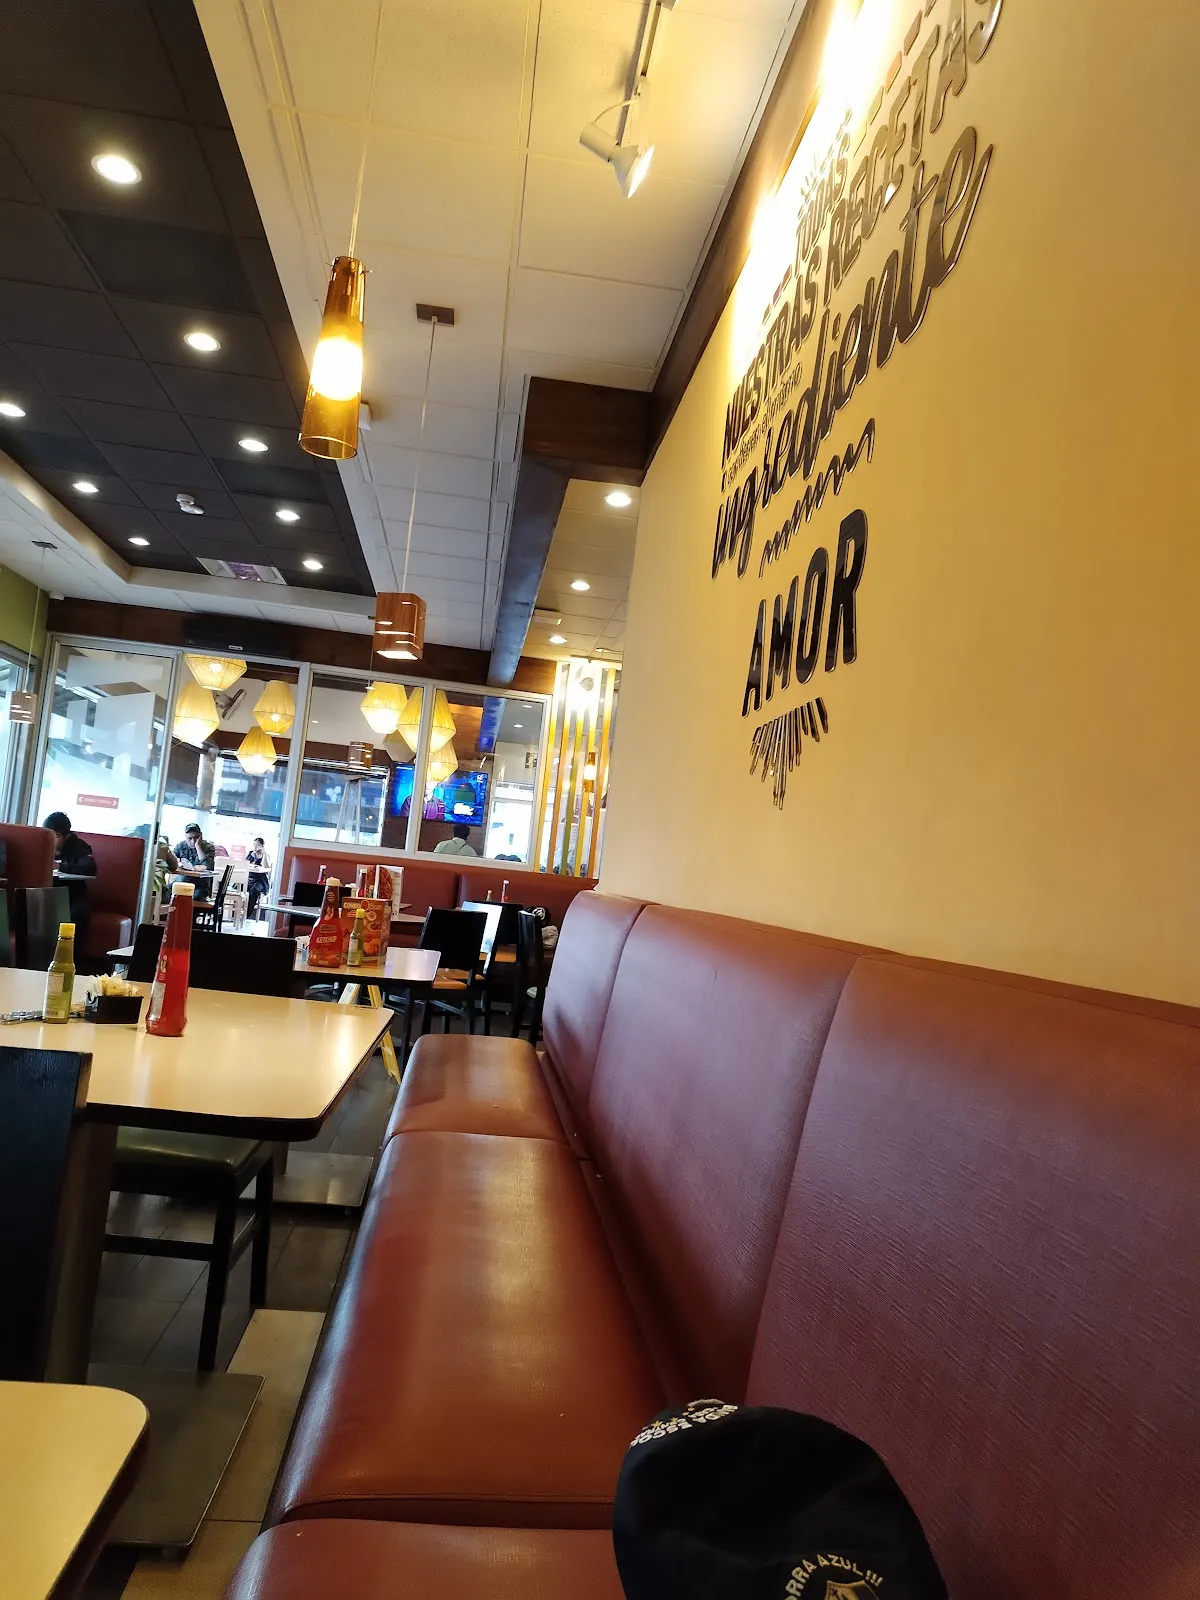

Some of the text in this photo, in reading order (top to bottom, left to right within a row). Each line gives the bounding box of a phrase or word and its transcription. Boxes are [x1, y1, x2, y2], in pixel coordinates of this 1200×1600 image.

[795, 131, 850, 273] TODAS
[711, 126, 995, 580] ingrediente
[720, 244, 822, 471] NUESTRAS
[741, 508, 869, 719] AMOR
[816, 1553, 864, 1577] AZUL
